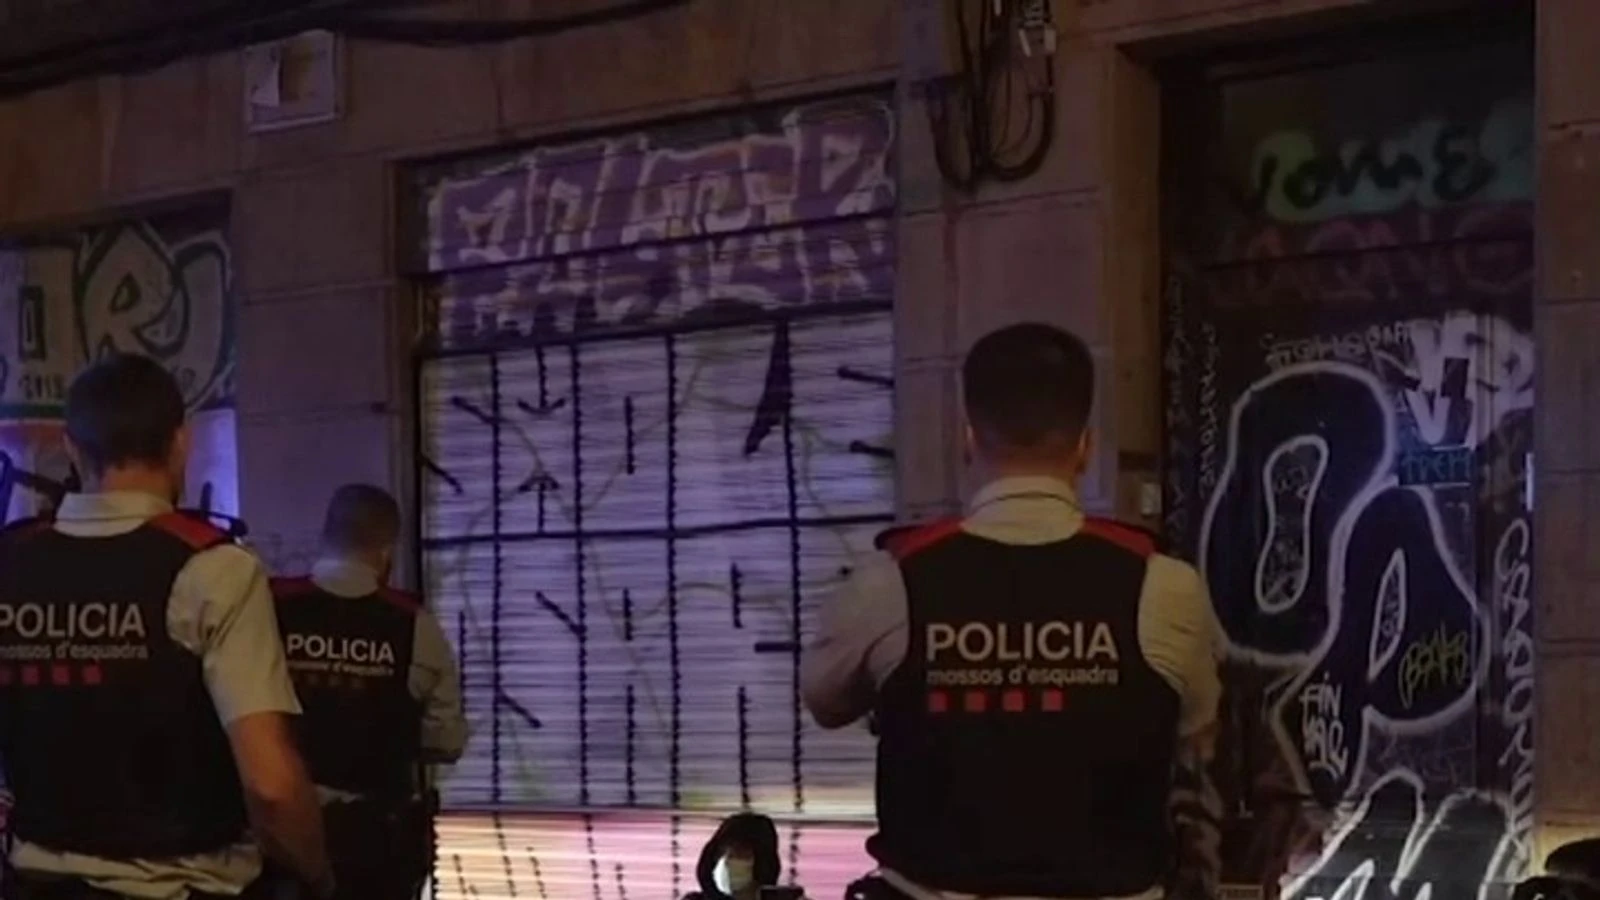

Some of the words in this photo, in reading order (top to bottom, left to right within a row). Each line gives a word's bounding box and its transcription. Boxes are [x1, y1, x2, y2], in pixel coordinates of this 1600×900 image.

[0, 602, 146, 639] POLICIA
[286, 632, 396, 665] POLICIA
[926, 620, 1119, 663] POLICIA
[927, 667, 1004, 686] mossos
[1008, 663, 1120, 687] d'esquadra
